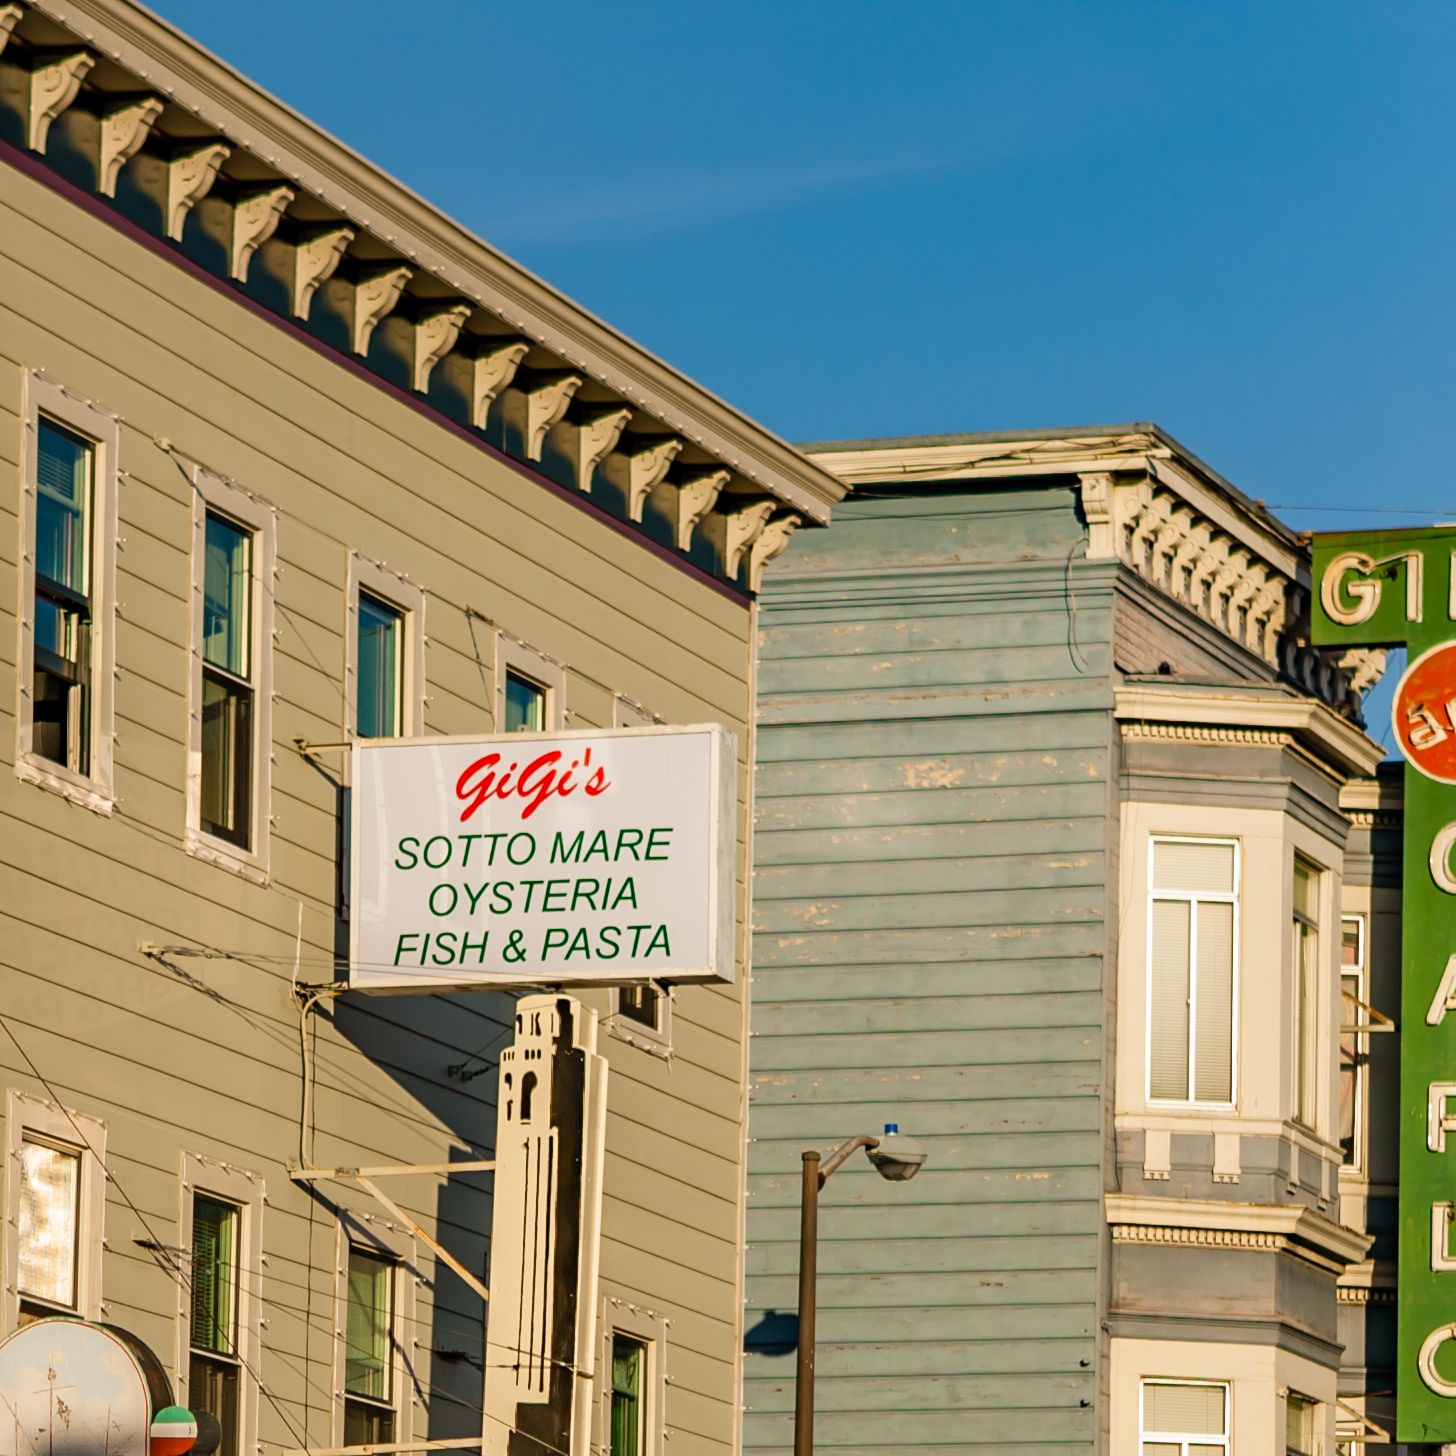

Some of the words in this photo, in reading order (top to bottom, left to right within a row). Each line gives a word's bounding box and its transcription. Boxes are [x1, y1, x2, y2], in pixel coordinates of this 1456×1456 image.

[456, 747, 611, 823] GiGi's
[394, 831, 537, 870] SOTTO
[549, 827, 674, 864] MARE
[428, 876, 639, 917] OYSTERIA
[393, 930, 489, 966] FISH
[502, 929, 528, 962] &
[541, 924, 672, 961] PASTA
